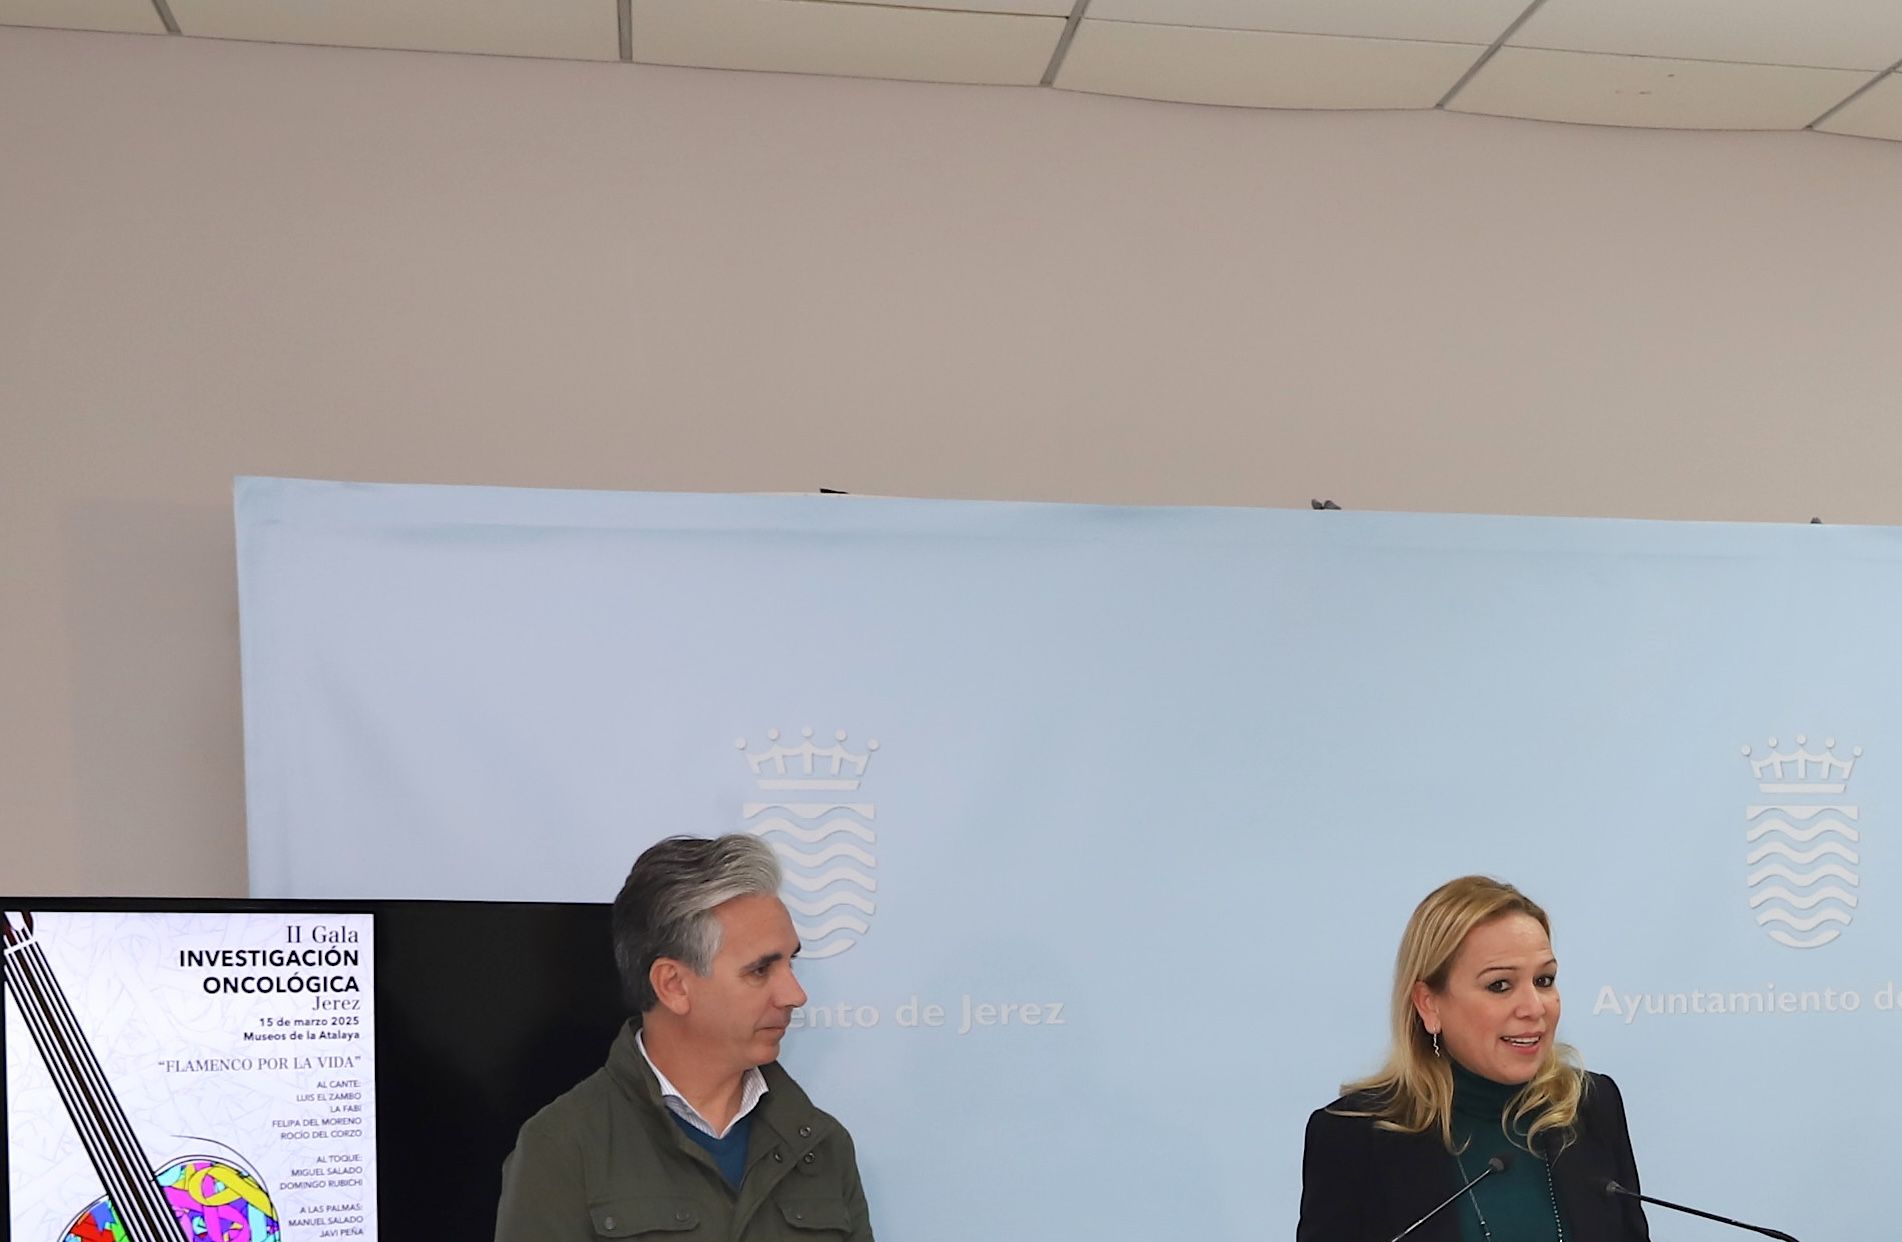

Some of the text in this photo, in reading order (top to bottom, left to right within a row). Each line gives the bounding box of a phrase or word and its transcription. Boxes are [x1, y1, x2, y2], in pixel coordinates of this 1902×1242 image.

[286, 925, 359, 943] II Gala
[180, 946, 358, 966] INVESTIGACIÓN
[203, 972, 360, 994] ONCOLÓGICA
[312, 996, 360, 1011] Jerez
[1593, 982, 1861, 1024] Ayuntamiento
[896, 995, 945, 1027] de
[958, 993, 1066, 1035] Jerez
[260, 1018, 273, 1027] 15
[277, 1018, 290, 1026] de
[331, 1016, 359, 1025] 2025
[243, 1030, 360, 1041] Museos de la Atalaya
[258, 1057, 289, 1070] POR
[294, 1057, 312, 1069] LA
[296, 1094, 315, 1102] LUIS
[329, 1092, 362, 1100] ZAMBO
[330, 1105, 341, 1113] LA
[321, 1117, 362, 1125] MORENO
[330, 1129, 362, 1138] CORZO
[291, 1166, 363, 1177] MIGUEL SALADO
[280, 1180, 326, 1190] DOMINGO
[308, 1205, 324, 1213] LAS
[288, 1216, 364, 1227] MANUEL SALADO
[319, 1229, 339, 1238] JAVI
